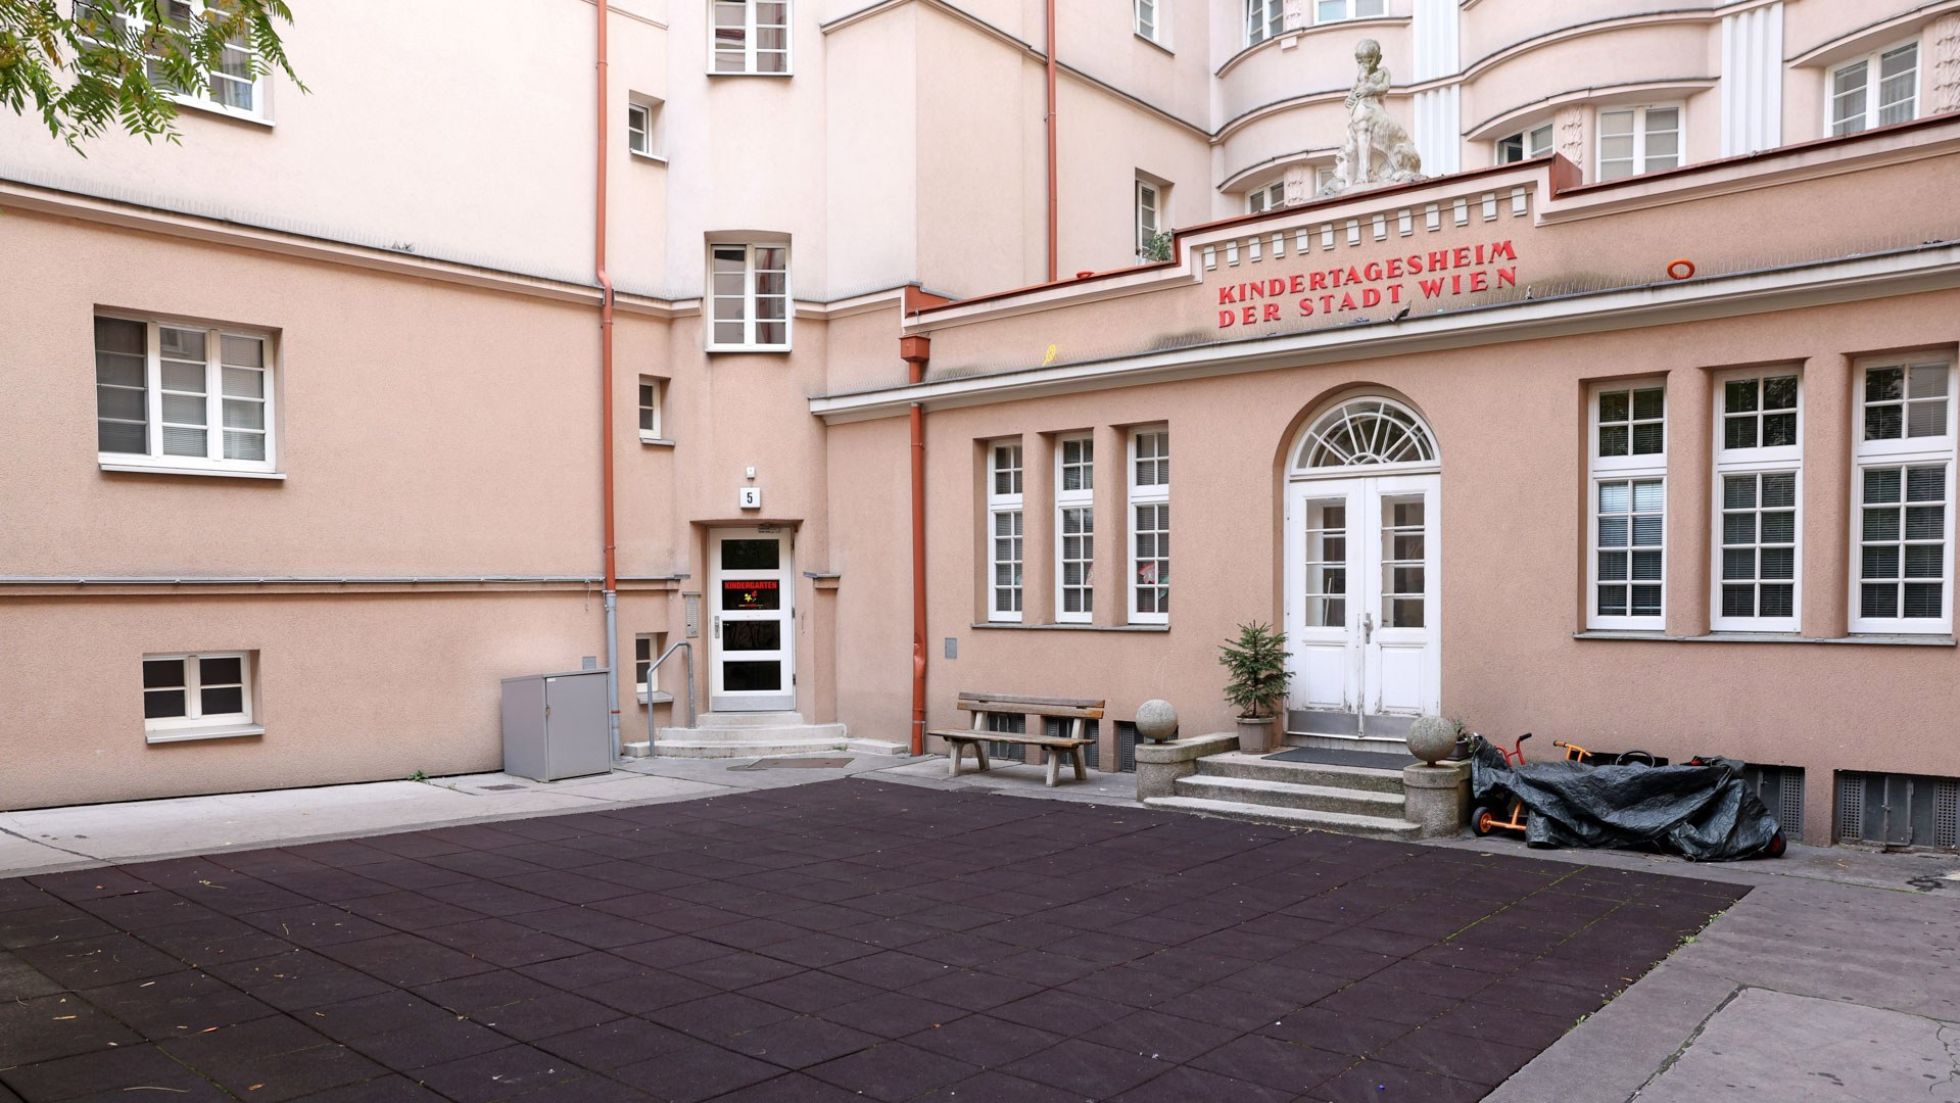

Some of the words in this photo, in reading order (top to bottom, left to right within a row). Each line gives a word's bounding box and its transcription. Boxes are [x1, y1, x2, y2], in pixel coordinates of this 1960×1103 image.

[1219, 240, 1517, 304] KINDERTAGESHEIM
[1219, 303, 1281, 328] DER
[1300, 284, 1403, 317] STADT
[1419, 266, 1517, 299] WIEN
[746, 491, 753, 504] 5
[724, 581, 778, 590] KINDERGARTEN
